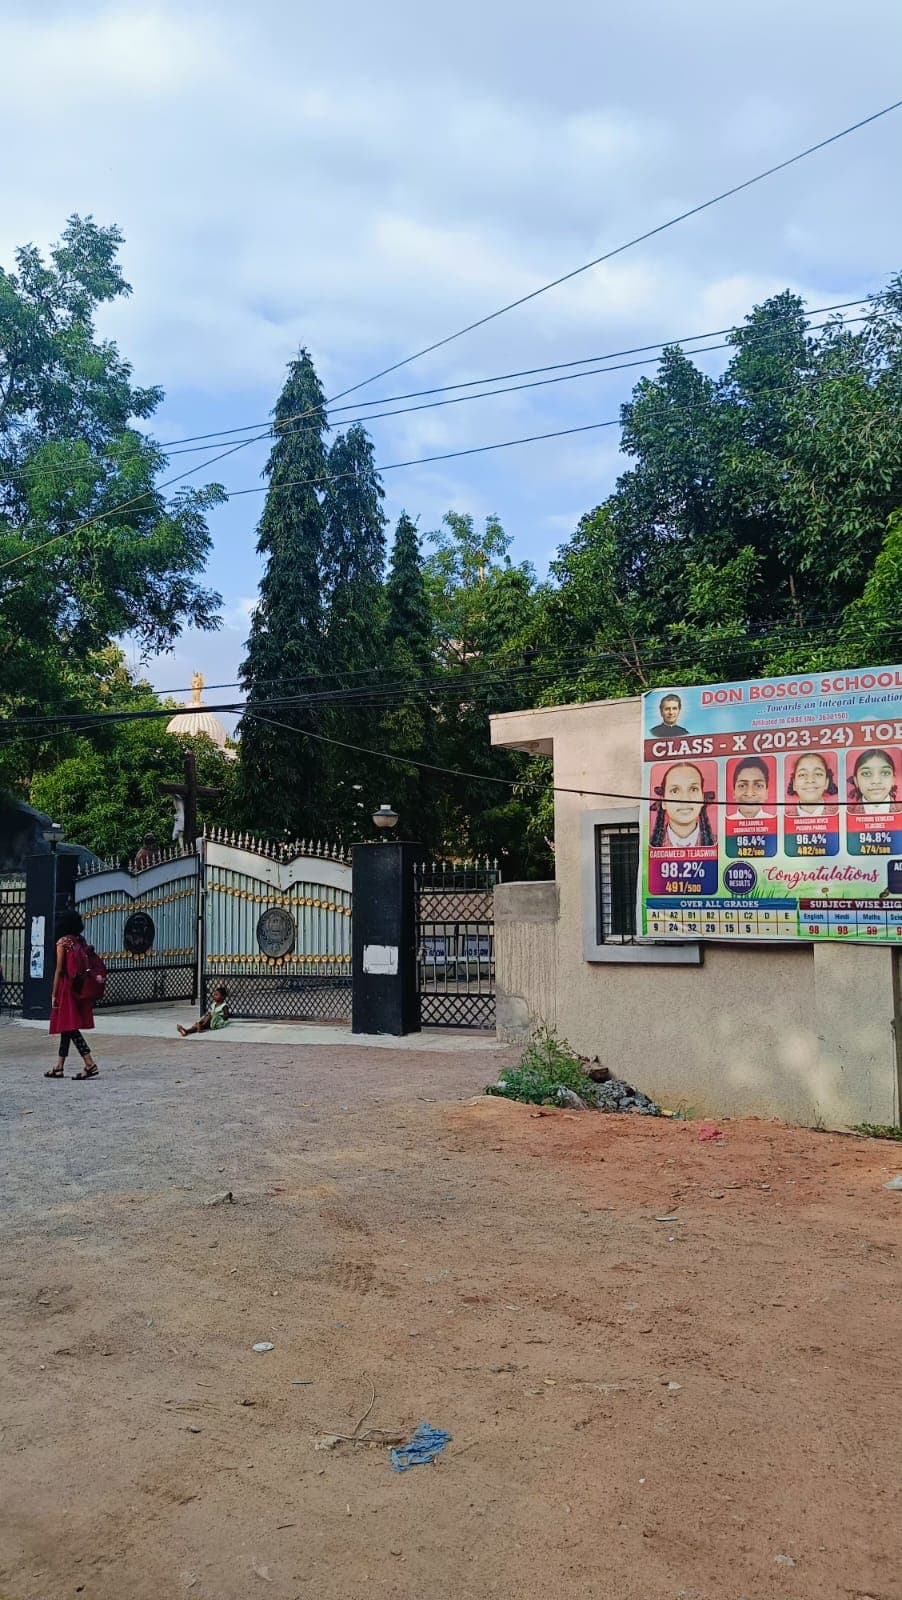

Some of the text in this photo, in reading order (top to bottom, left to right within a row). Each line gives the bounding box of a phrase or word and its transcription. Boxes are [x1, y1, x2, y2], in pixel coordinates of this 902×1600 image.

[701, 671, 902, 705] DON BOSCO SCHOOL
[804, 702, 816, 710] an
[818, 695, 856, 710] Integral
[652, 736, 714, 758] CLASS
[732, 735, 748, 752] X
[752, 726, 854, 753] (2023-24)
[736, 835, 766, 846] 96.4%
[796, 834, 827, 845] 96.4%
[859, 832, 892, 843] 94.8%
[737, 847, 765, 857] 482/500
[860, 845, 891, 854] 474/500
[660, 861, 705, 878] 98.2%
[728, 869, 753, 879] 100%
[763, 865, 879, 890] Congratulations
[665, 881, 702, 893] 491/500
[809, 900, 853, 908] SUBJECT
[855, 901, 880, 909] WISE
[651, 911, 660, 919] A1
[669, 911, 678, 919] A2
[706, 911, 715, 919] B2
[743, 912, 753, 920] C2
[803, 913, 824, 921] English
[653, 923, 659, 932] 9
[669, 923, 679, 932] 24
[687, 923, 697, 932] 32
[725, 923, 734, 932] 15
[745, 924, 751, 933] 5
[808, 925, 820, 934] 98
